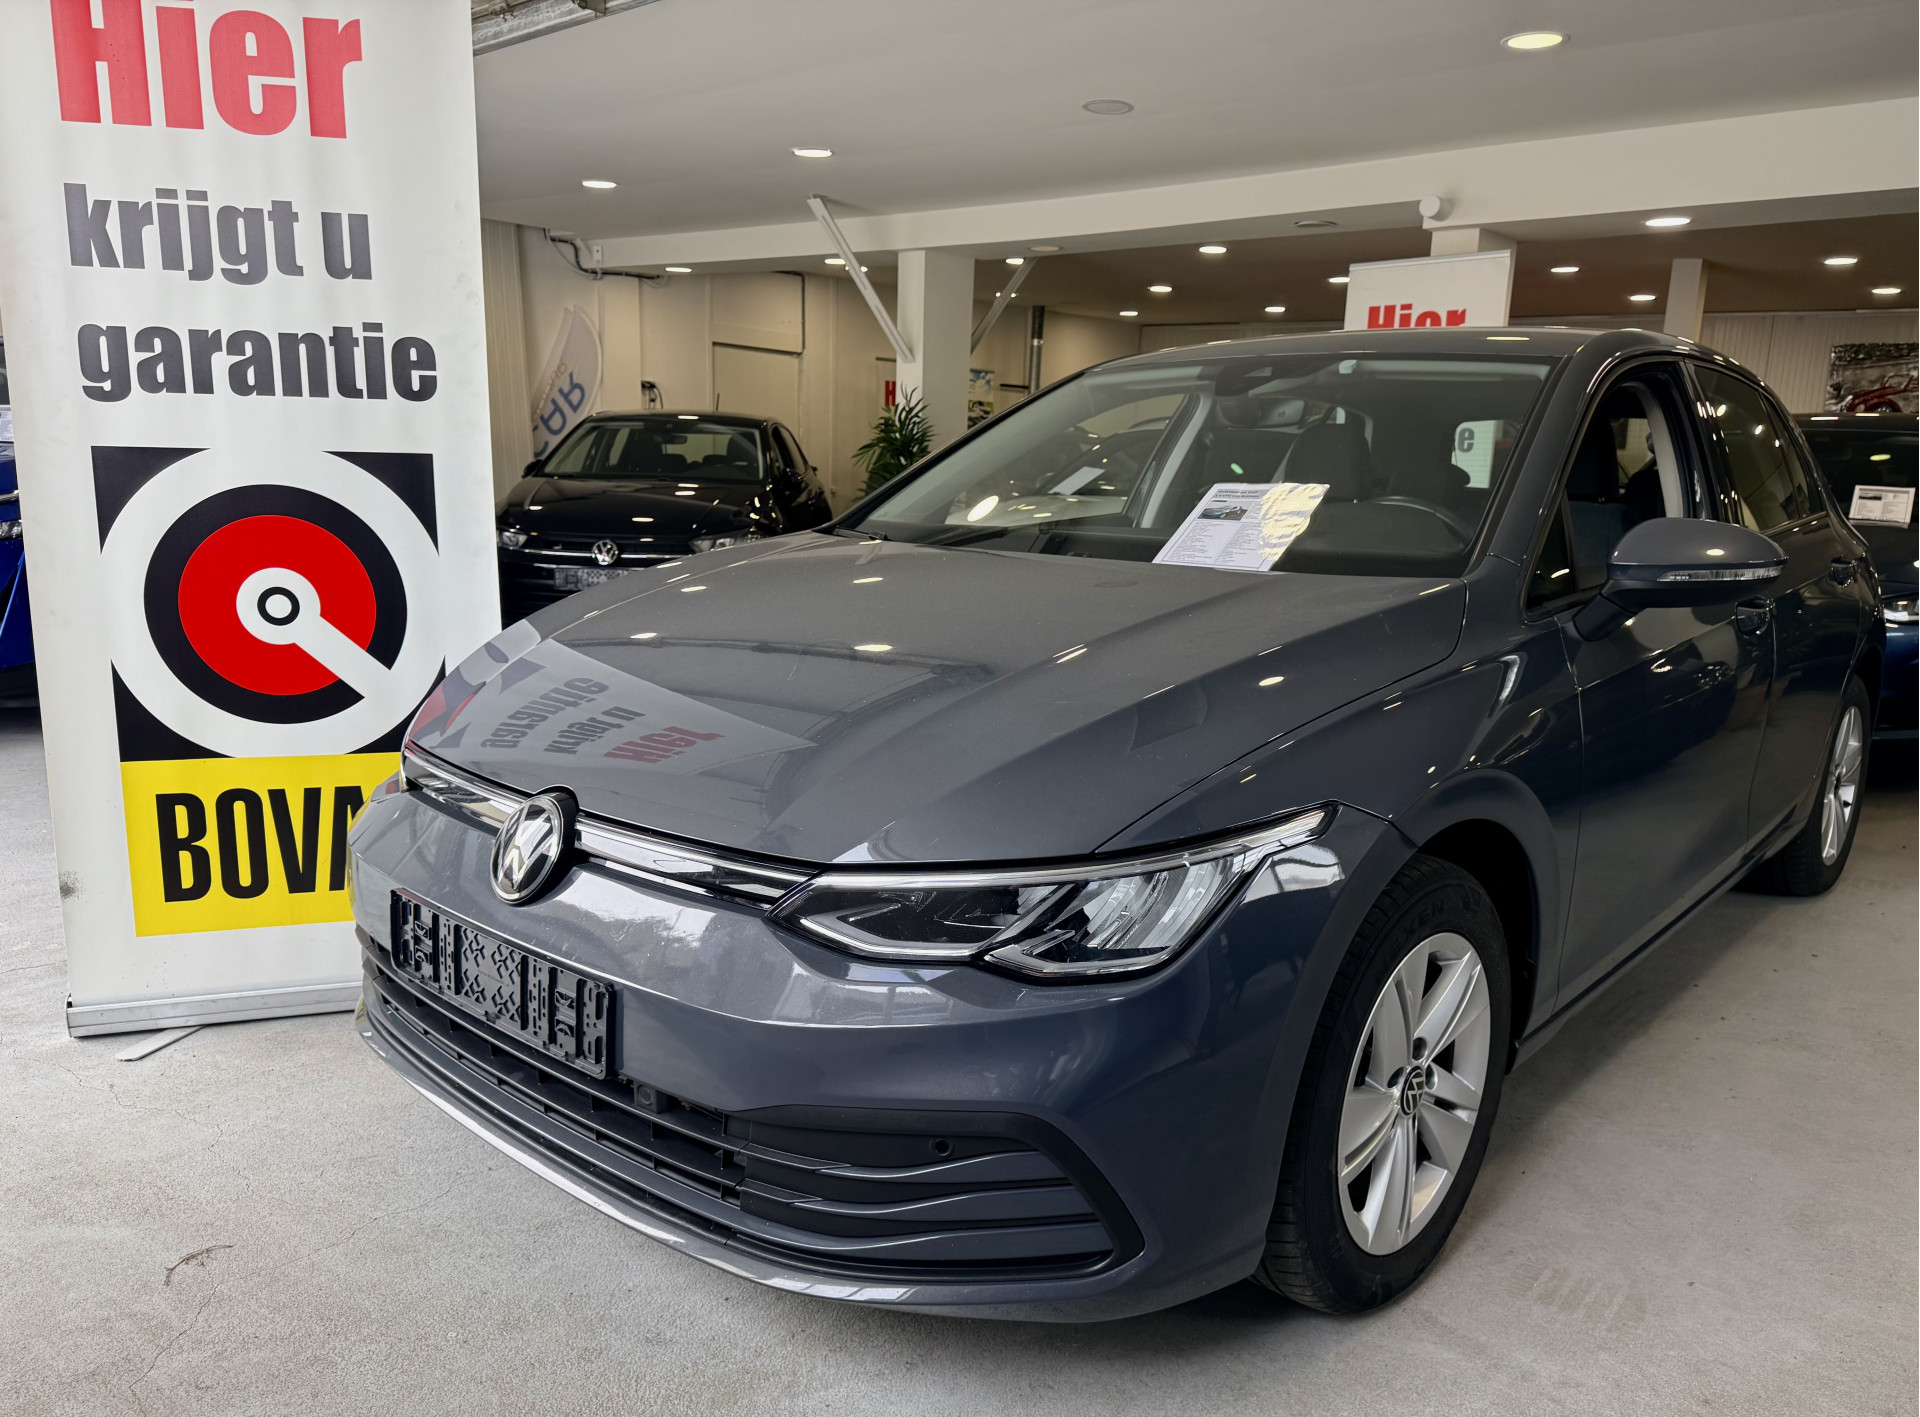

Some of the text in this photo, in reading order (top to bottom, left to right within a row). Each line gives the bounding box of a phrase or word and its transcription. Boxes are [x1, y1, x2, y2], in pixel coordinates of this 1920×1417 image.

[50, 0, 362, 139] Hier
[63, 182, 373, 285] krijgt u
[77, 321, 438, 402] garantie
